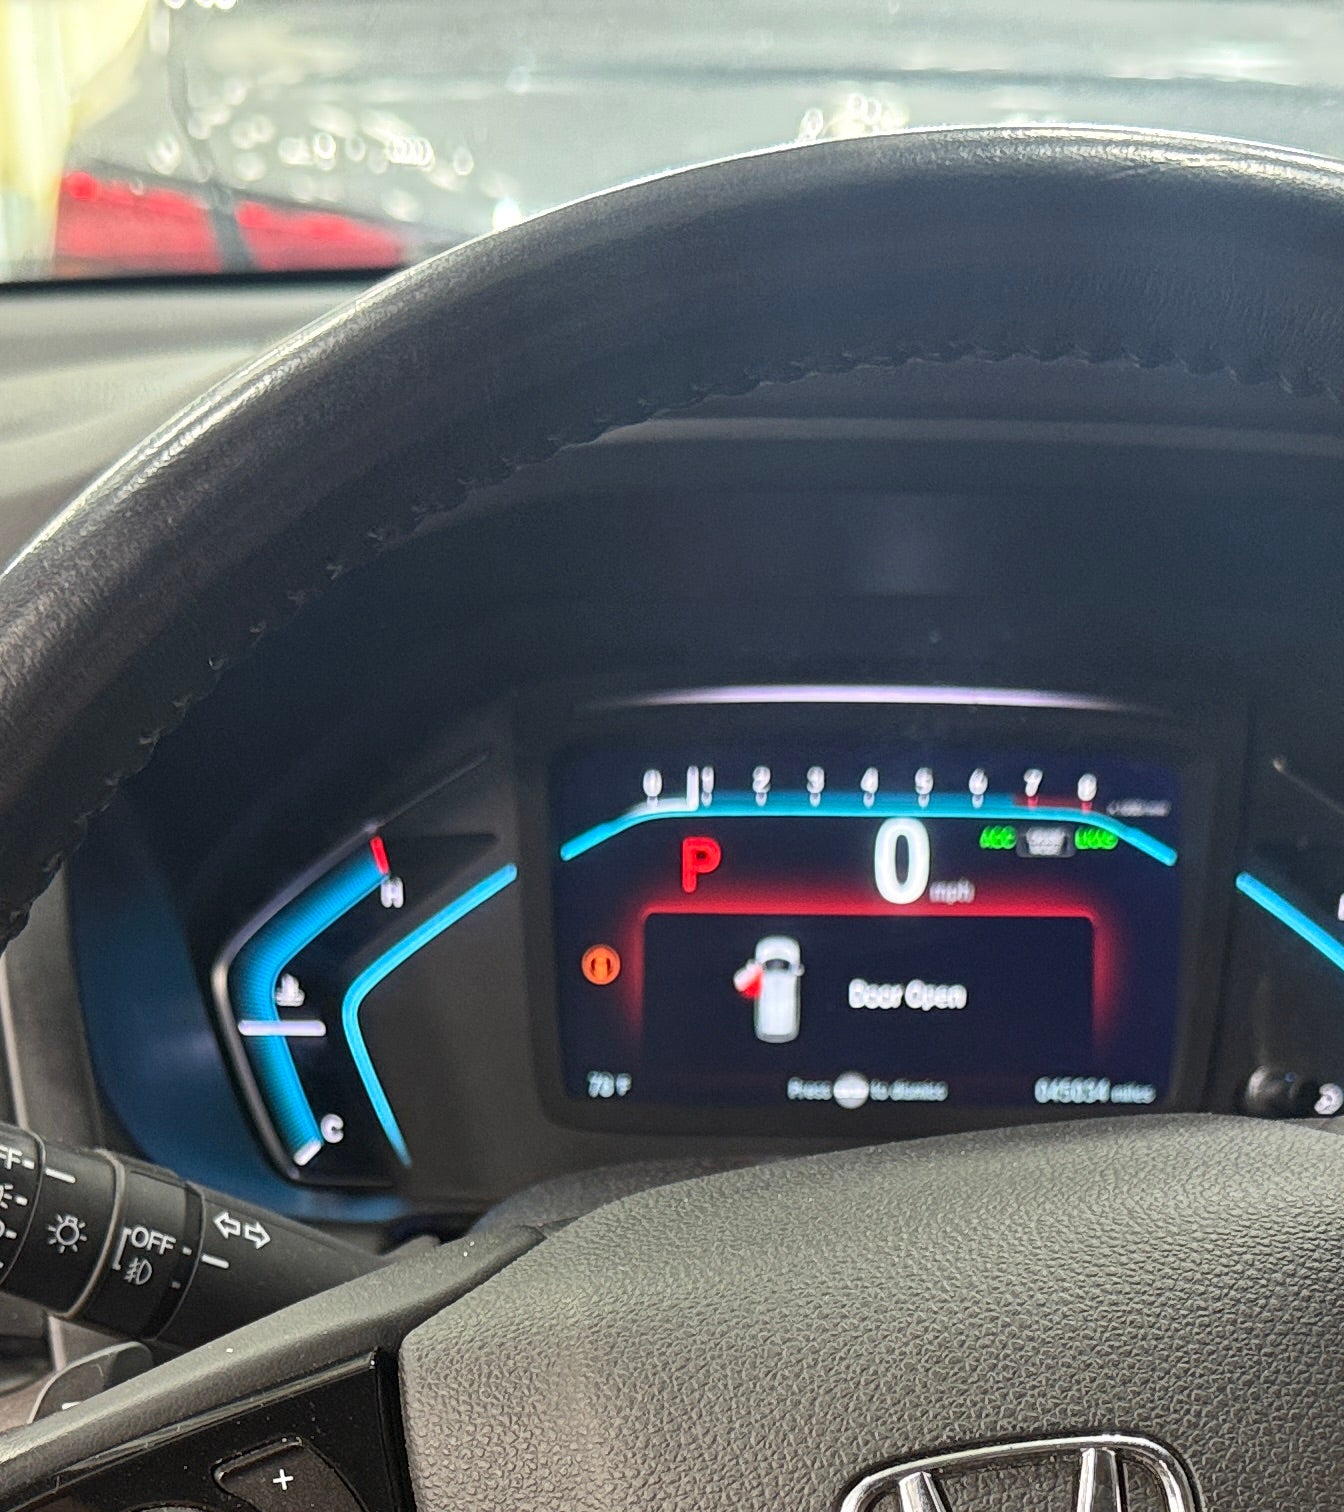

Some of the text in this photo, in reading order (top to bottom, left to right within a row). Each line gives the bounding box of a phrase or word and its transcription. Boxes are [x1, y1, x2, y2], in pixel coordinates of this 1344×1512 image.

[682, 835, 722, 893] P
[874, 816, 930, 905] 0
[848, 978, 968, 1012] Door Open
[129, 1224, 177, 1257] OFF
